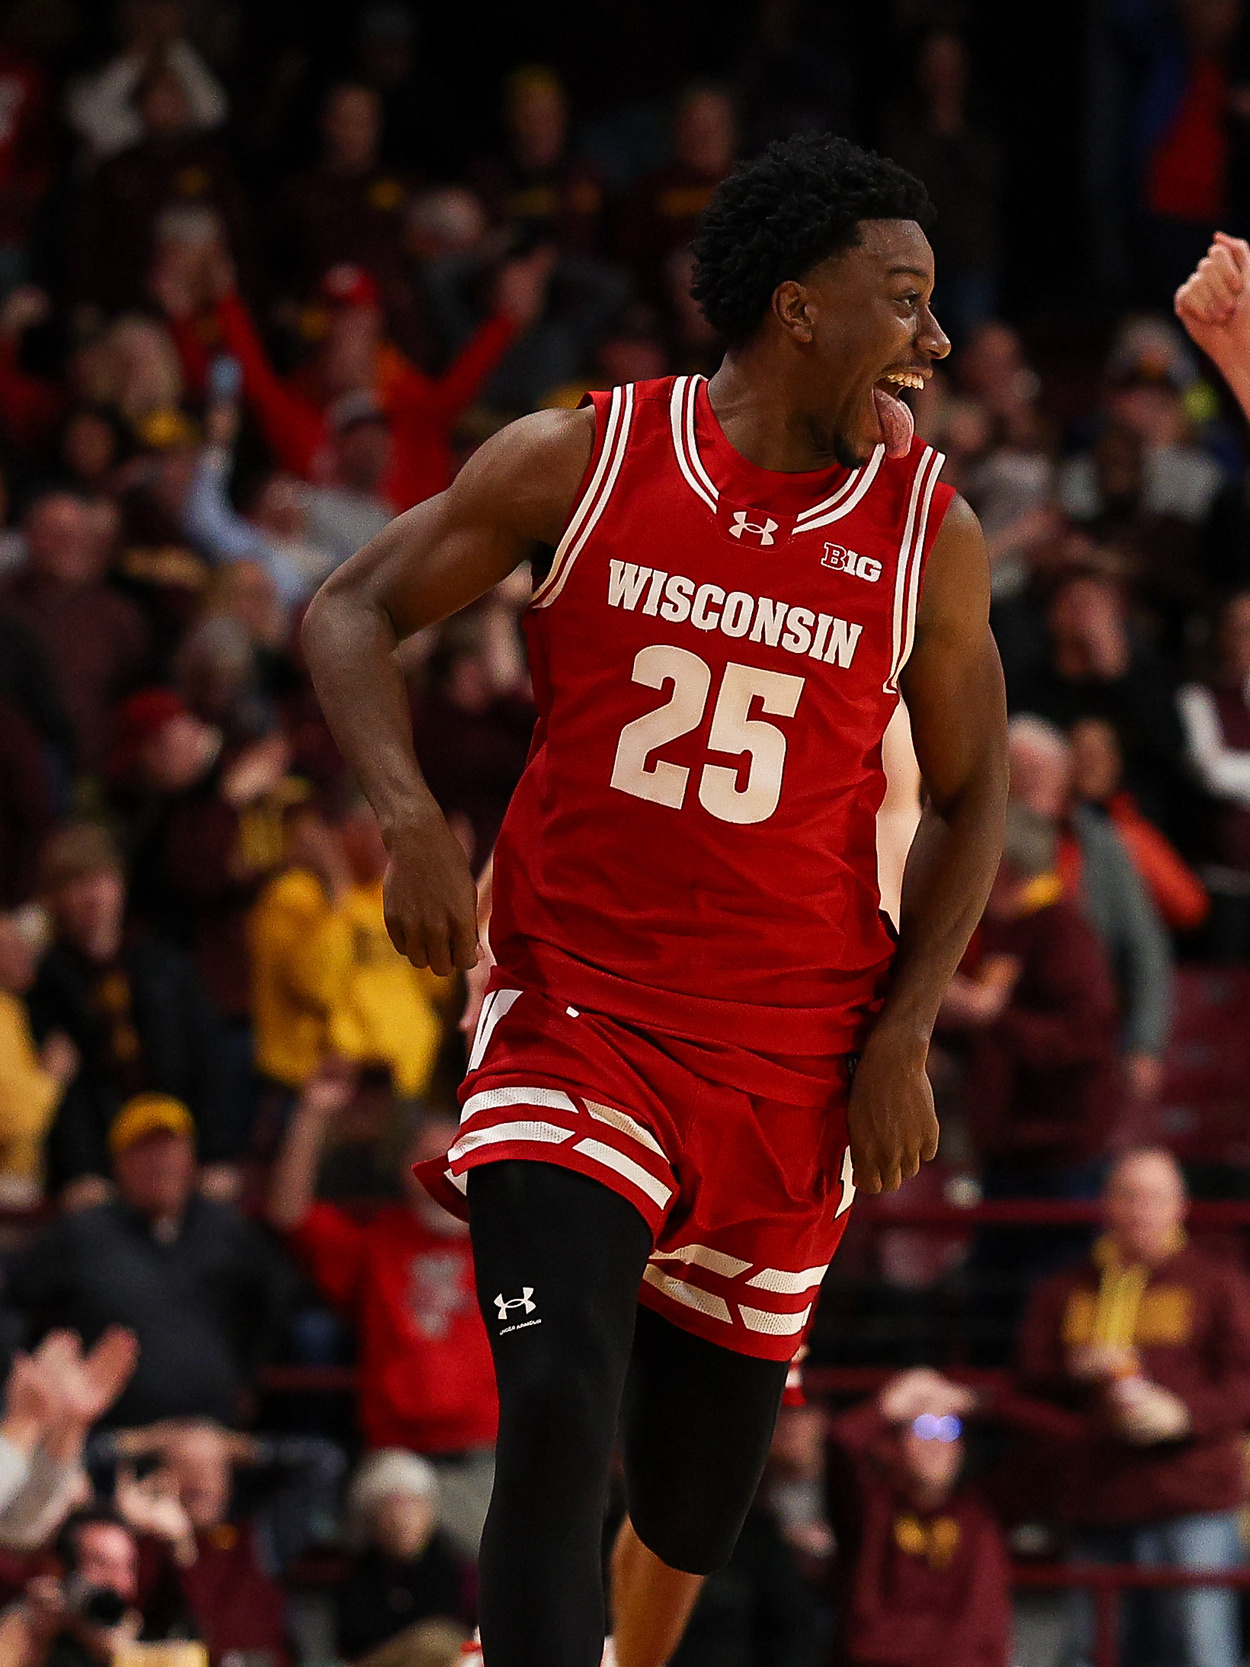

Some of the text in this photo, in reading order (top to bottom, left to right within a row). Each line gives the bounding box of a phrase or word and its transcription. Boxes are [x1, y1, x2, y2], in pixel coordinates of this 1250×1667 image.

[607, 558, 863, 669] WISCONSIN
[820, 541, 882, 582] BIG
[609, 644, 806, 824] 25
